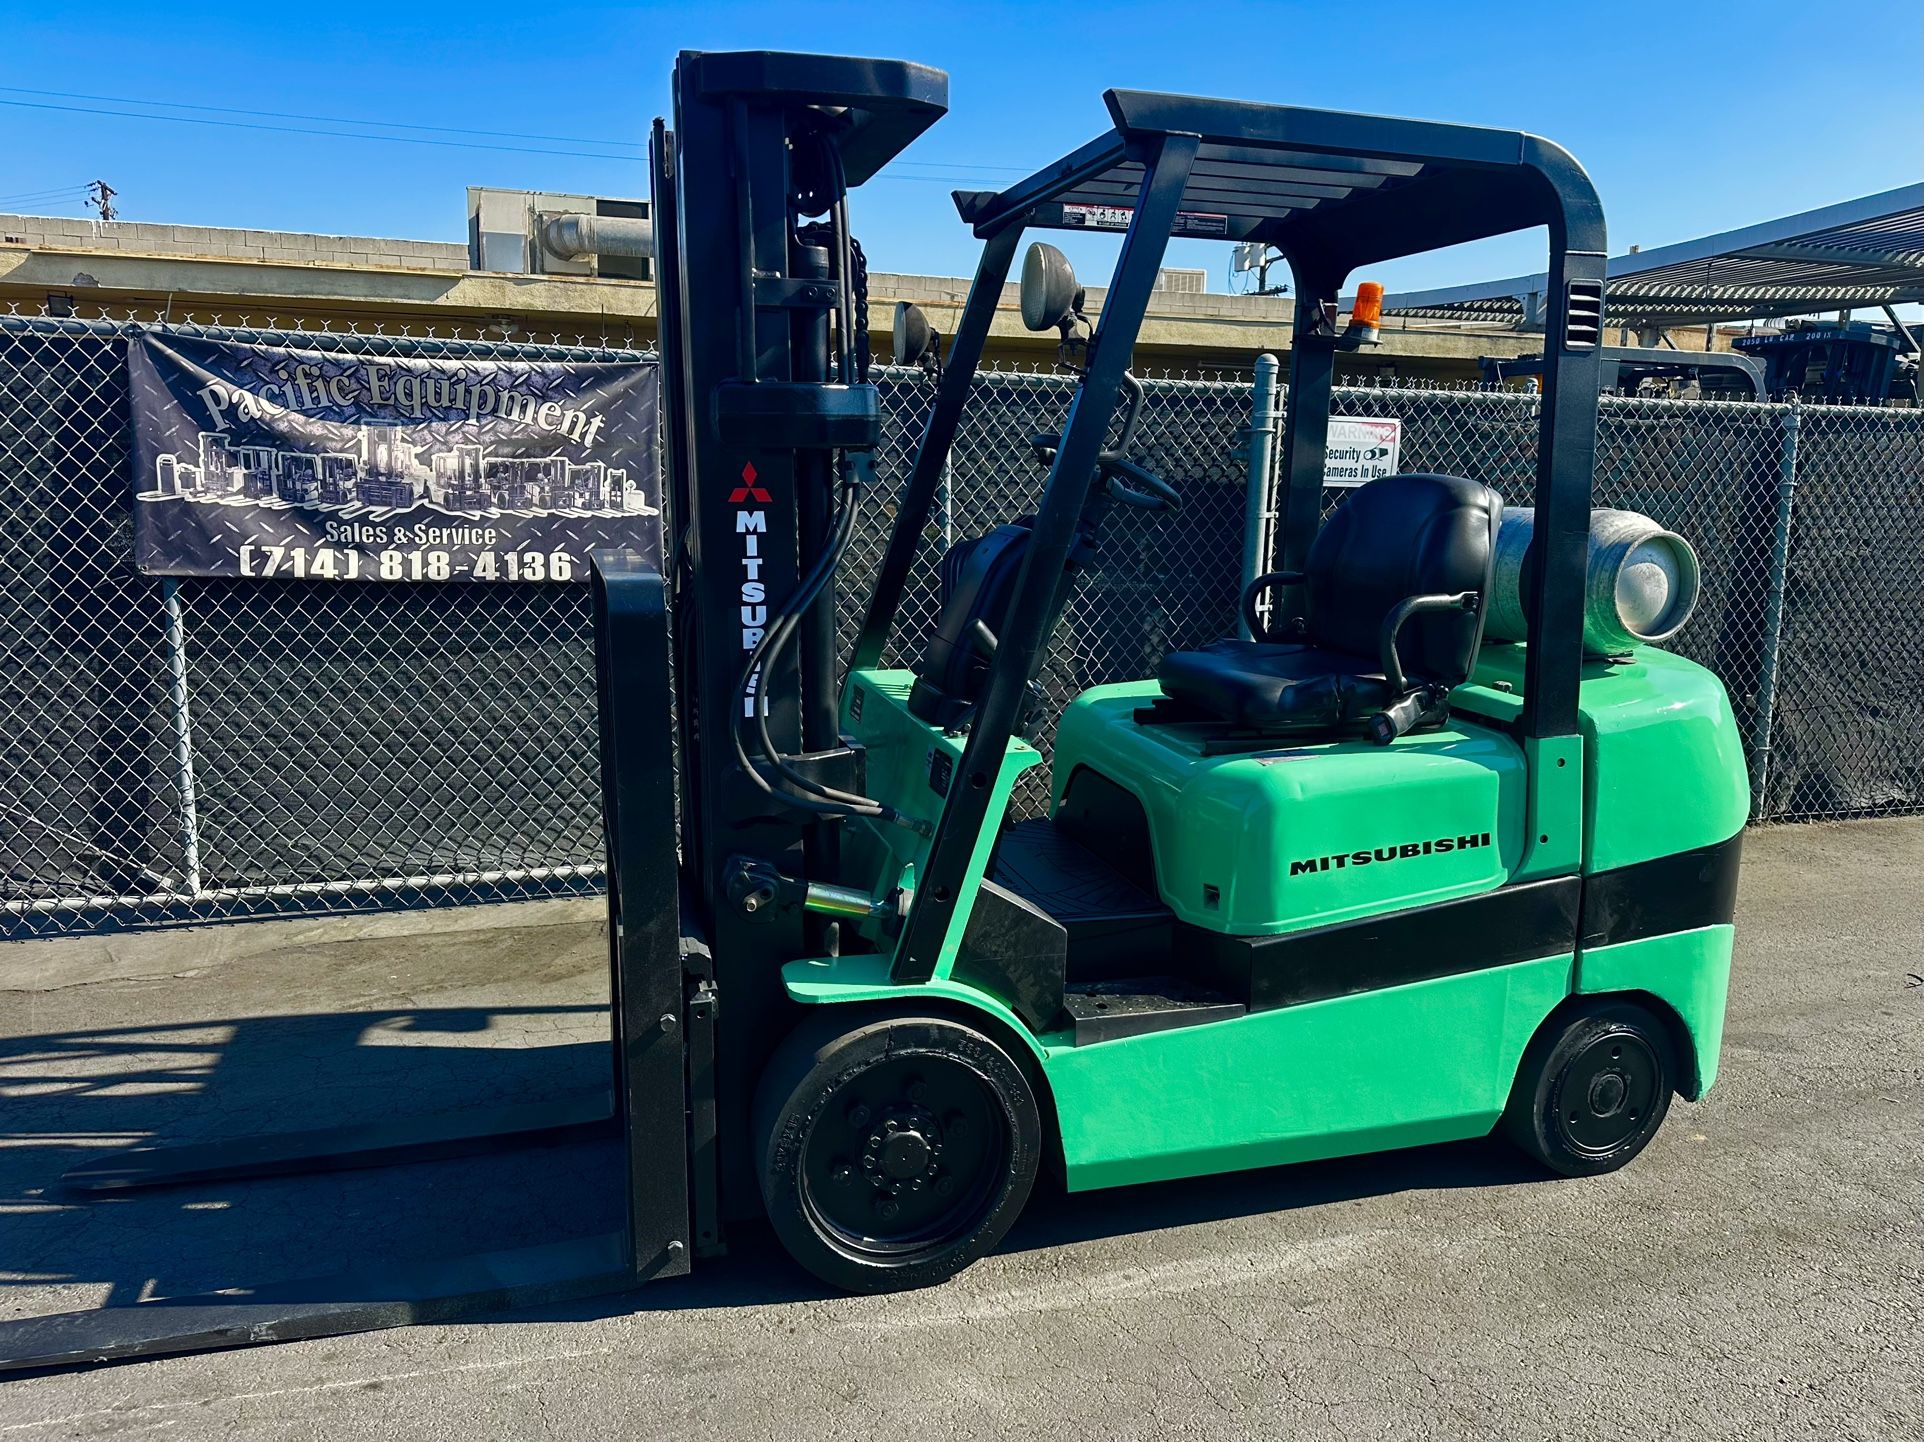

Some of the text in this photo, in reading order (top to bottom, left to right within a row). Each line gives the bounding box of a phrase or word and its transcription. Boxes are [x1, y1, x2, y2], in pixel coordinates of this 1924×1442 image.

[197, 364, 606, 448] Pacific Equipment
[1360, 464, 1370, 479] In
[1371, 465, 1387, 478] Use
[325, 520, 497, 545] Sales & Service
[239, 544, 573, 581] (714) 818-4136
[1290, 832, 1490, 876] MITSUBISHI
